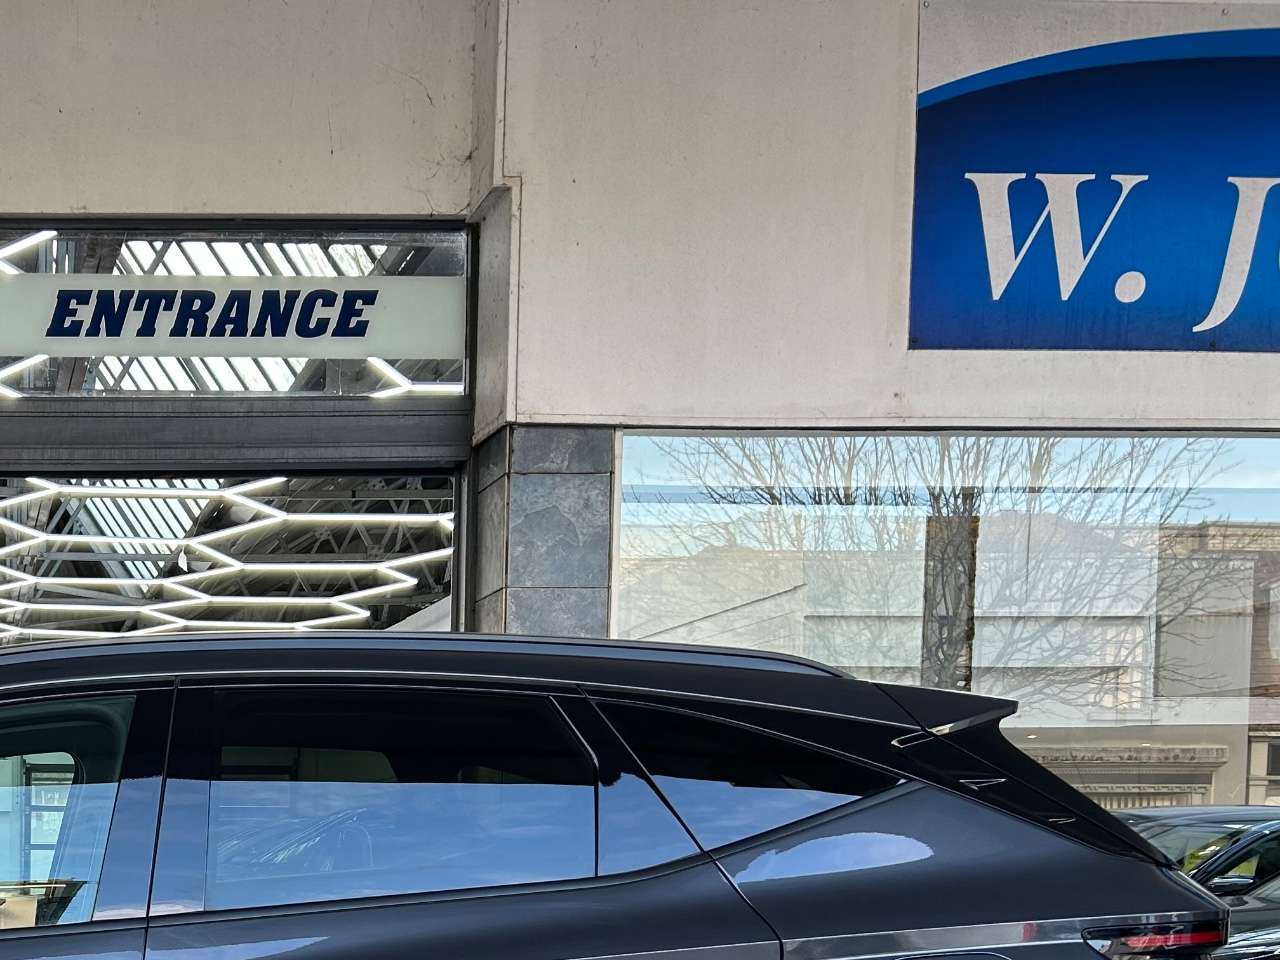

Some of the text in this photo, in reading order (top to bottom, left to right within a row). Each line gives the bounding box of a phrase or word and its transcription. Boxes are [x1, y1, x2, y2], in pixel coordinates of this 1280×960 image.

[964, 173, 1280, 332] W. J
[45, 289, 379, 338] ENTRANCE
